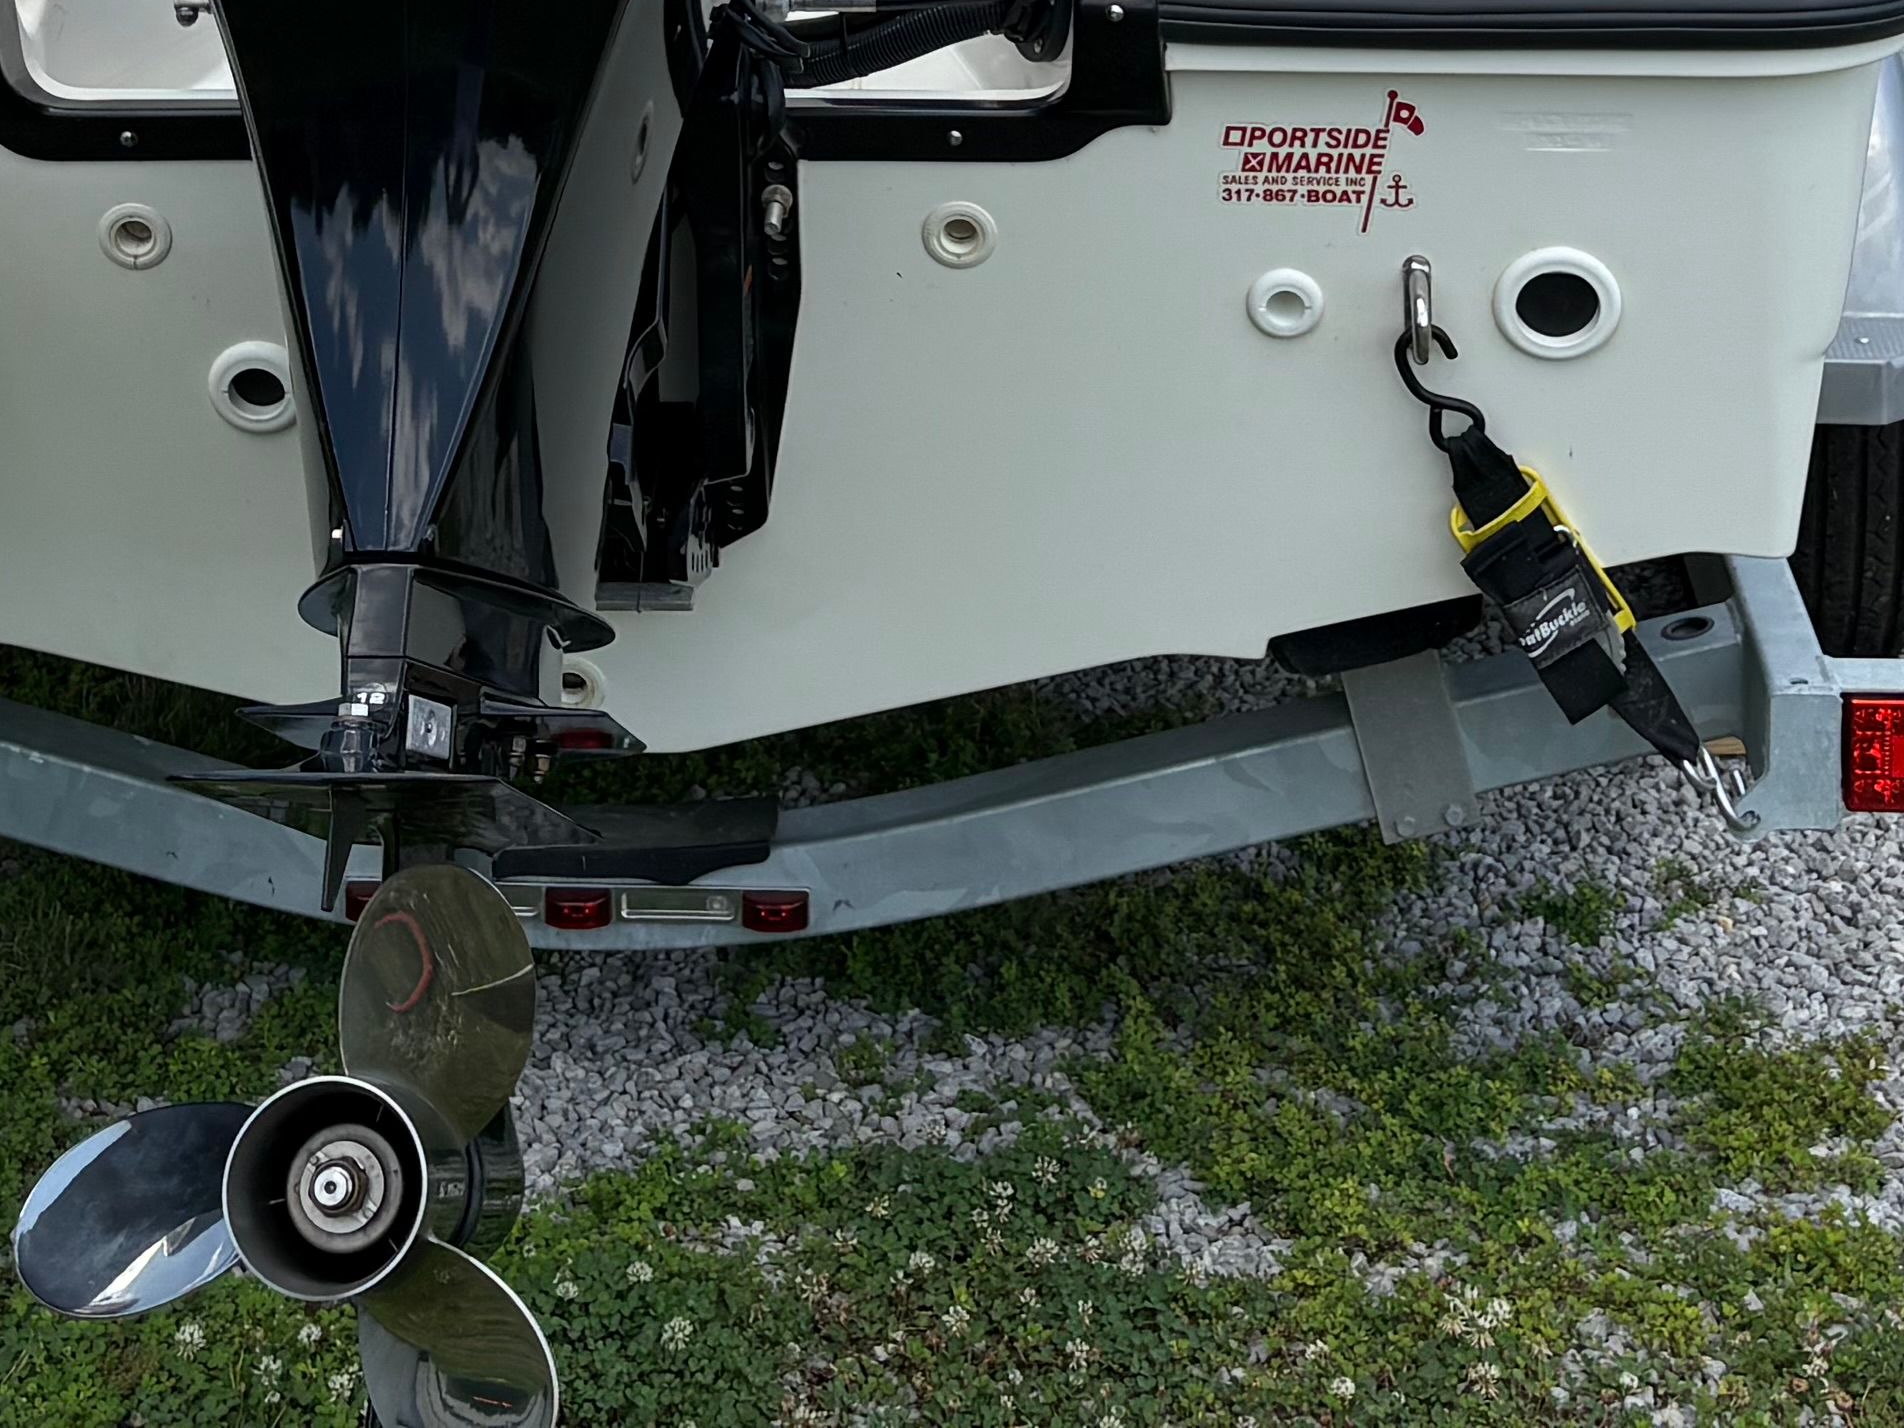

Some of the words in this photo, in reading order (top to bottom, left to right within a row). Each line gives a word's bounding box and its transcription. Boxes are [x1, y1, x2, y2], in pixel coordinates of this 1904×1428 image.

[1247, 126, 1390, 150] PORTSIDE
[1267, 152, 1385, 175] MARINE
[1222, 175, 1259, 186] SALES
[1262, 176, 1287, 186] AND
[1291, 176, 1341, 187] SERVICE
[1345, 177, 1366, 187] INC
[357, 692, 386, 705] 12
